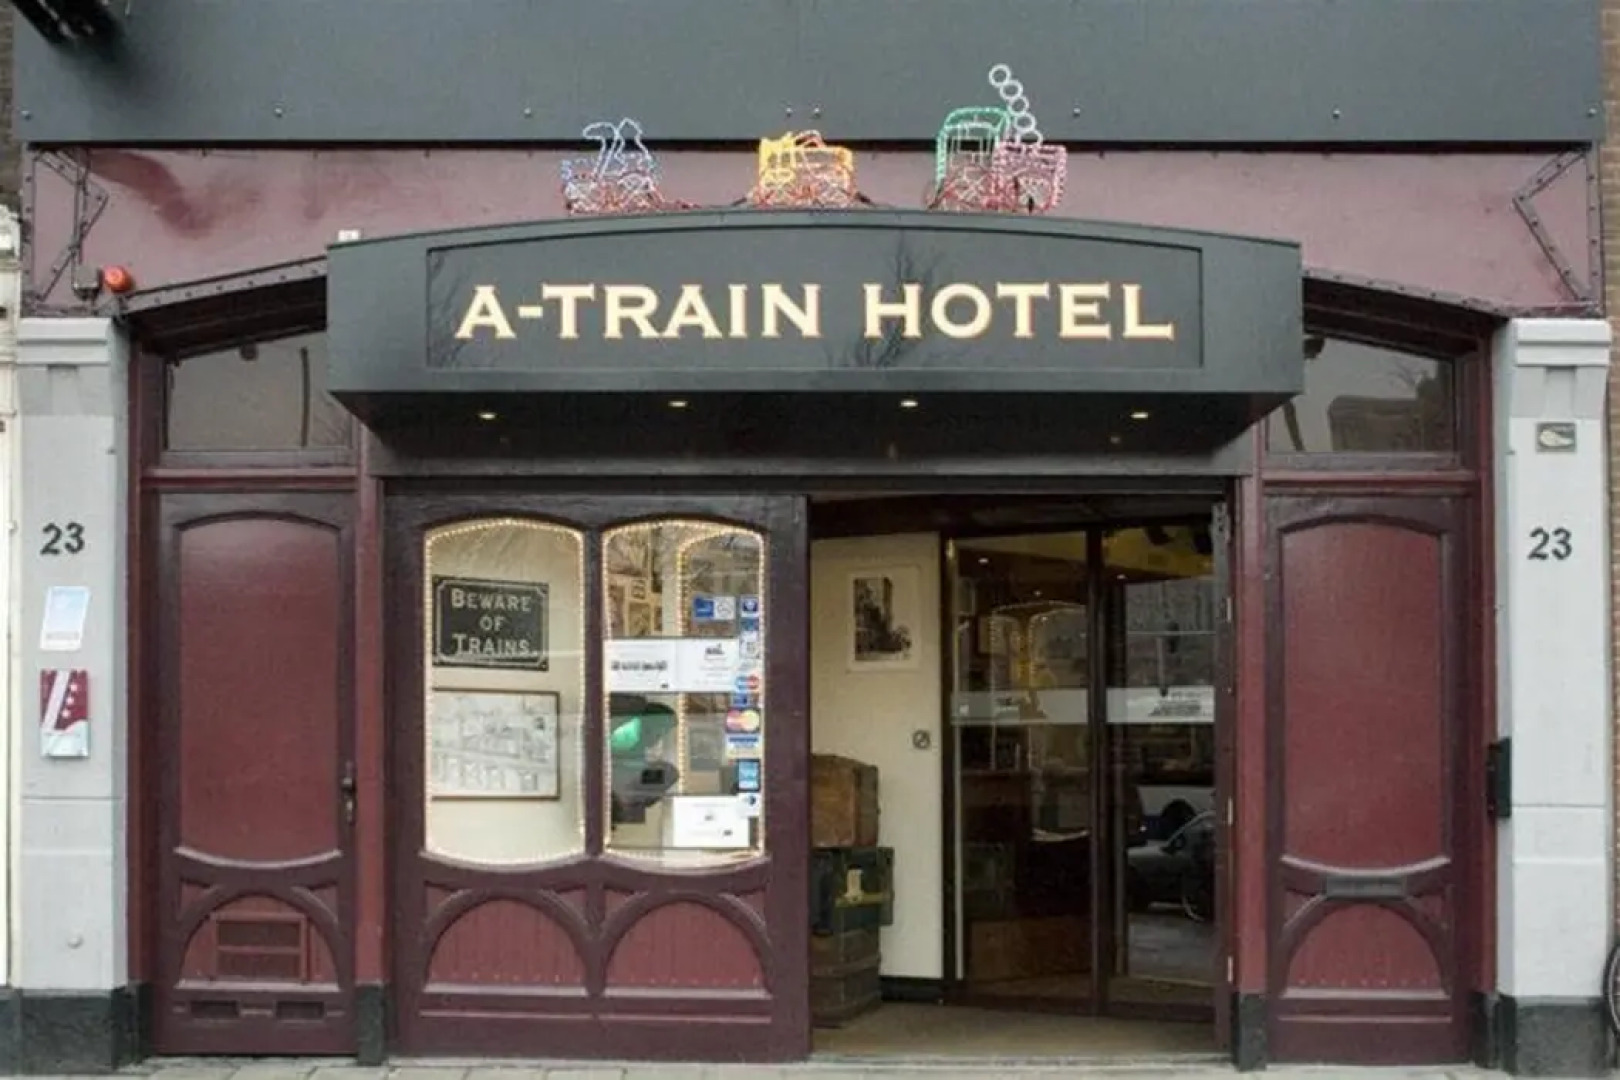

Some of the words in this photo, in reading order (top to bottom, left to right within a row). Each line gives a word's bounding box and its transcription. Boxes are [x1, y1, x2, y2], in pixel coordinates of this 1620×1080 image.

[454, 283, 822, 340] A-TRAIN
[863, 282, 1175, 340] HOTEL
[40, 521, 85, 556] 23
[1527, 526, 1573, 561] 23
[451, 587, 532, 612] BEWARE
[480, 615, 506, 631] OF
